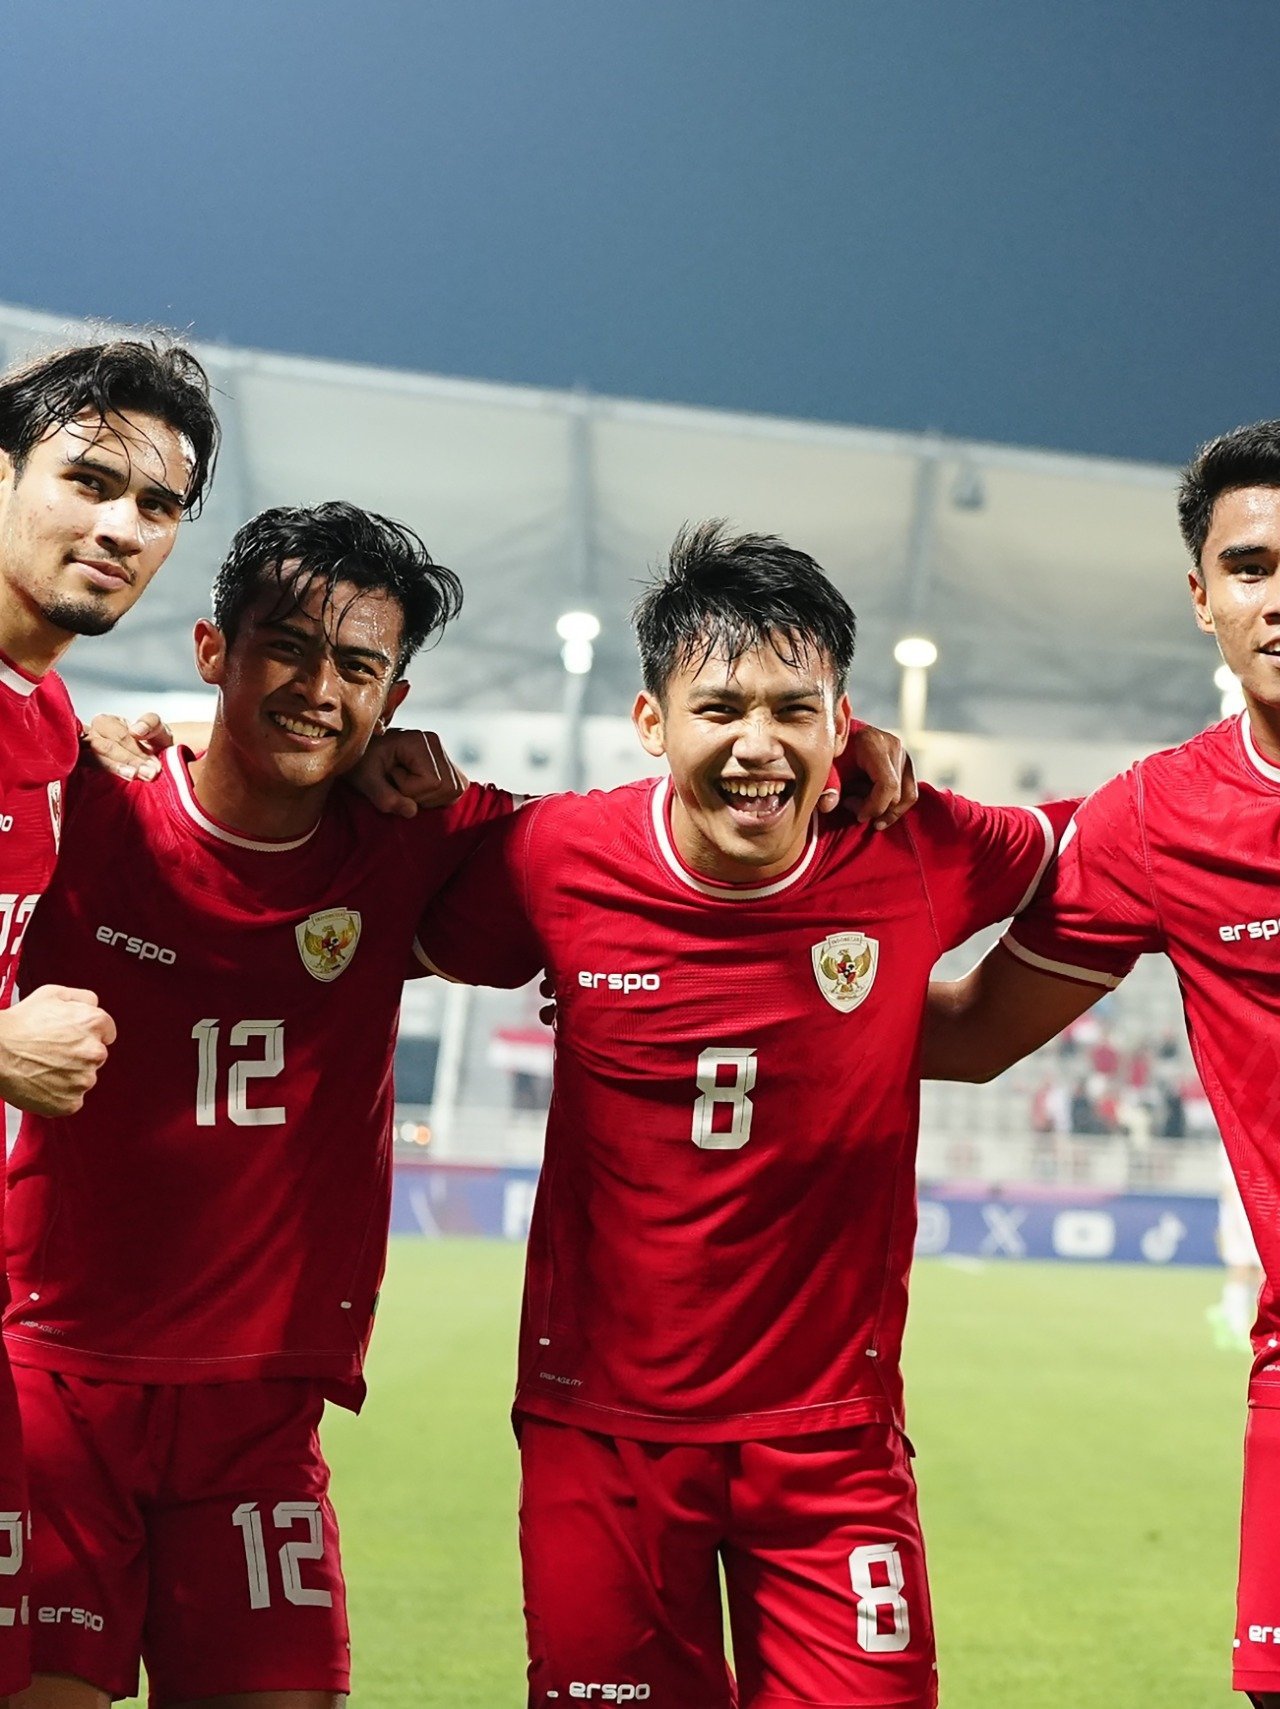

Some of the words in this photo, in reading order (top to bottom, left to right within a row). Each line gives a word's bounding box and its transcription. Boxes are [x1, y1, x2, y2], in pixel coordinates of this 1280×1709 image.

[96, 926, 177, 965] erspo
[578, 971, 660, 994] erspo
[192, 1019, 286, 1126] 12
[691, 1047, 757, 1150] 8
[232, 1502, 333, 1609] 12
[38, 1606, 104, 1632] erspo
[849, 1543, 910, 1652] 8
[569, 1681, 651, 1704] erspo
